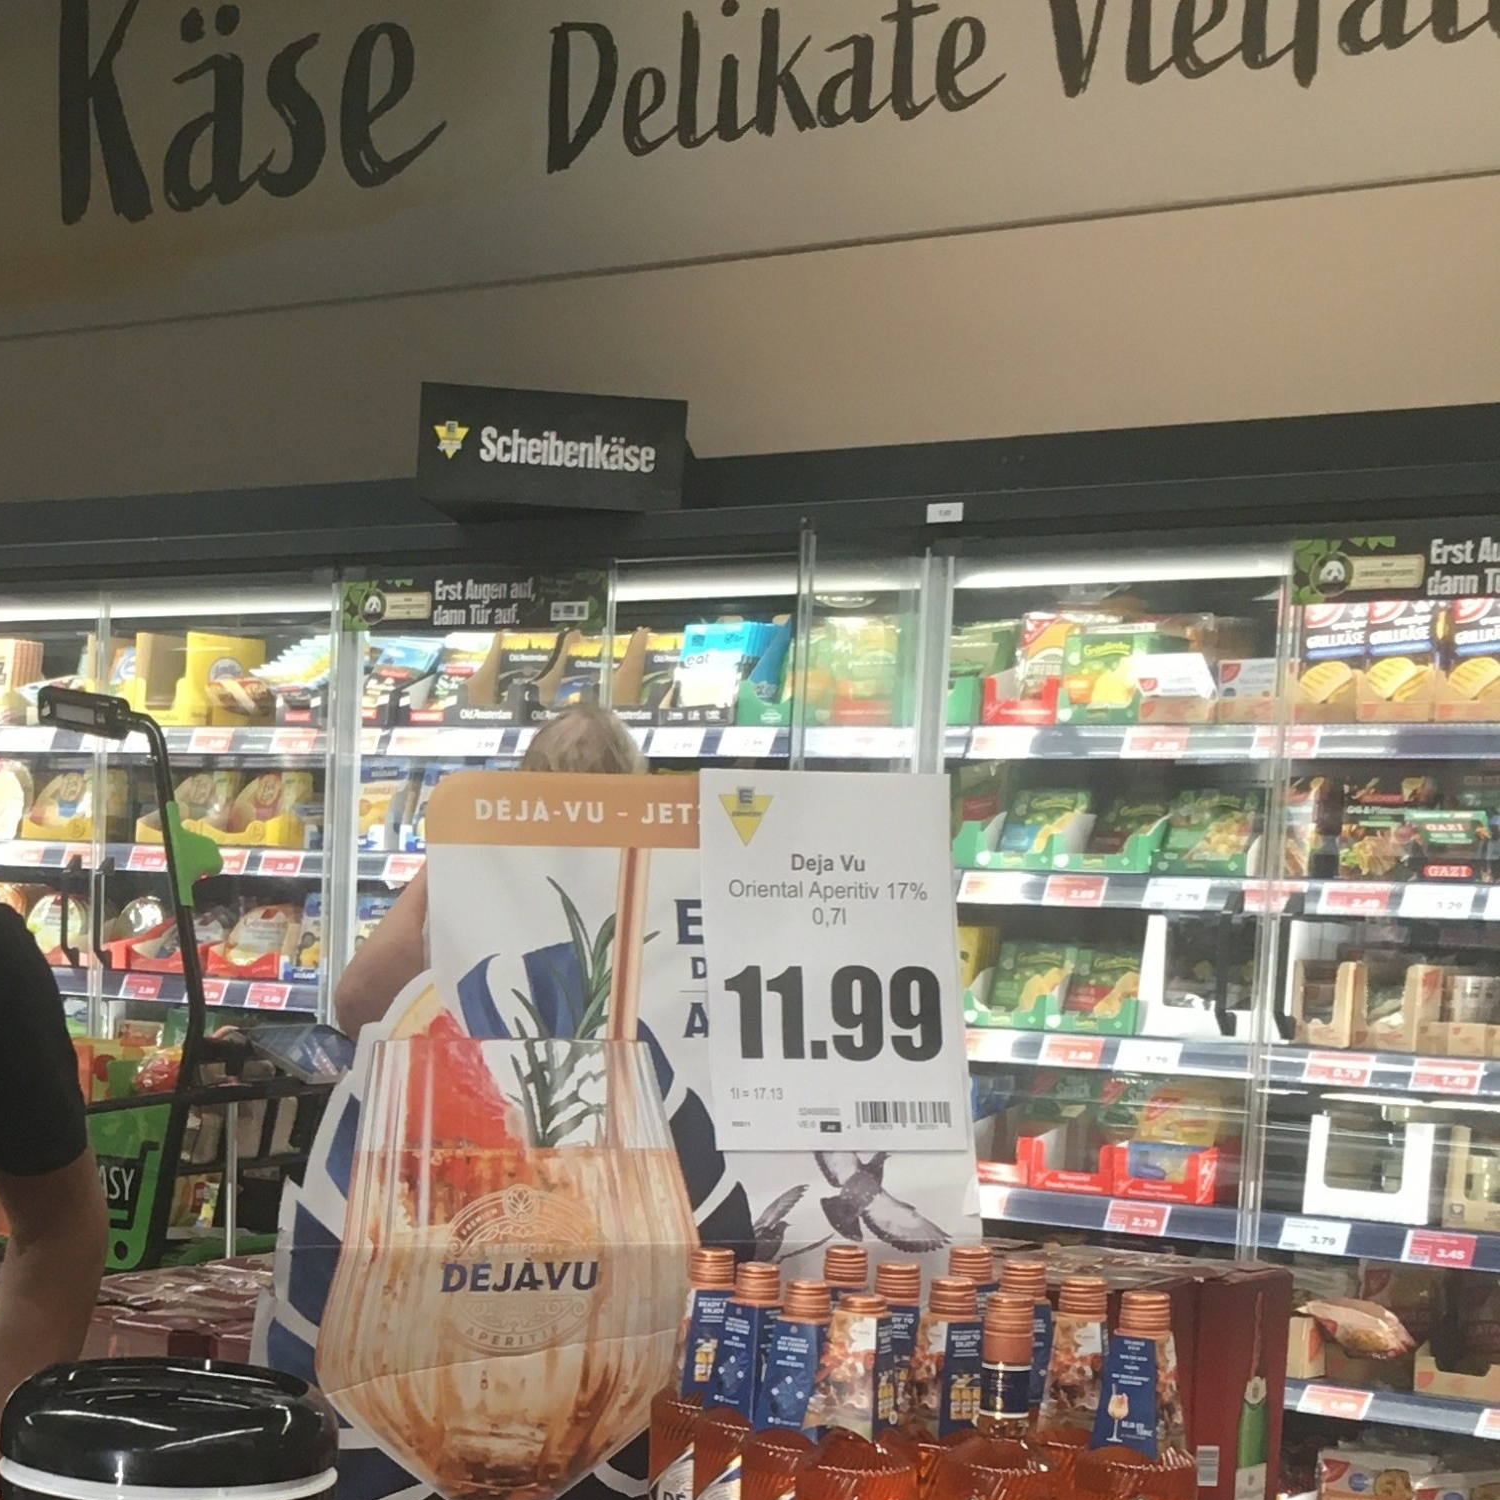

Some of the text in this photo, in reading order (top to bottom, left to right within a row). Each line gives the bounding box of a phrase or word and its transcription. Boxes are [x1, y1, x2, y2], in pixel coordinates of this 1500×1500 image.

[59, 0, 447, 226] Käse
[547, 0, 1007, 174] Delikate
[479, 425, 657, 474] Scheibenkäse
[1429, 538, 1475, 565] Erst
[434, 577, 537, 604] Erst Augen auf,
[1426, 569, 1480, 596] dann
[432, 606, 466, 627] dann
[469, 603, 492, 625] Tür
[494, 602, 520, 625] auf.
[475, 796, 701, 825] DÉJÀ-VU JET
[791, 853, 866, 876] Deja Vu
[1428, 865, 1469, 878] GAZI
[728, 879, 928, 903] Oriental Aperitiv 17%
[723, 964, 944, 1063] 11.99
[753, 1087, 784, 1100] 17.13
[1310, 1235, 1337, 1246] 3.79
[465, 1326, 558, 1347] APERITIF
